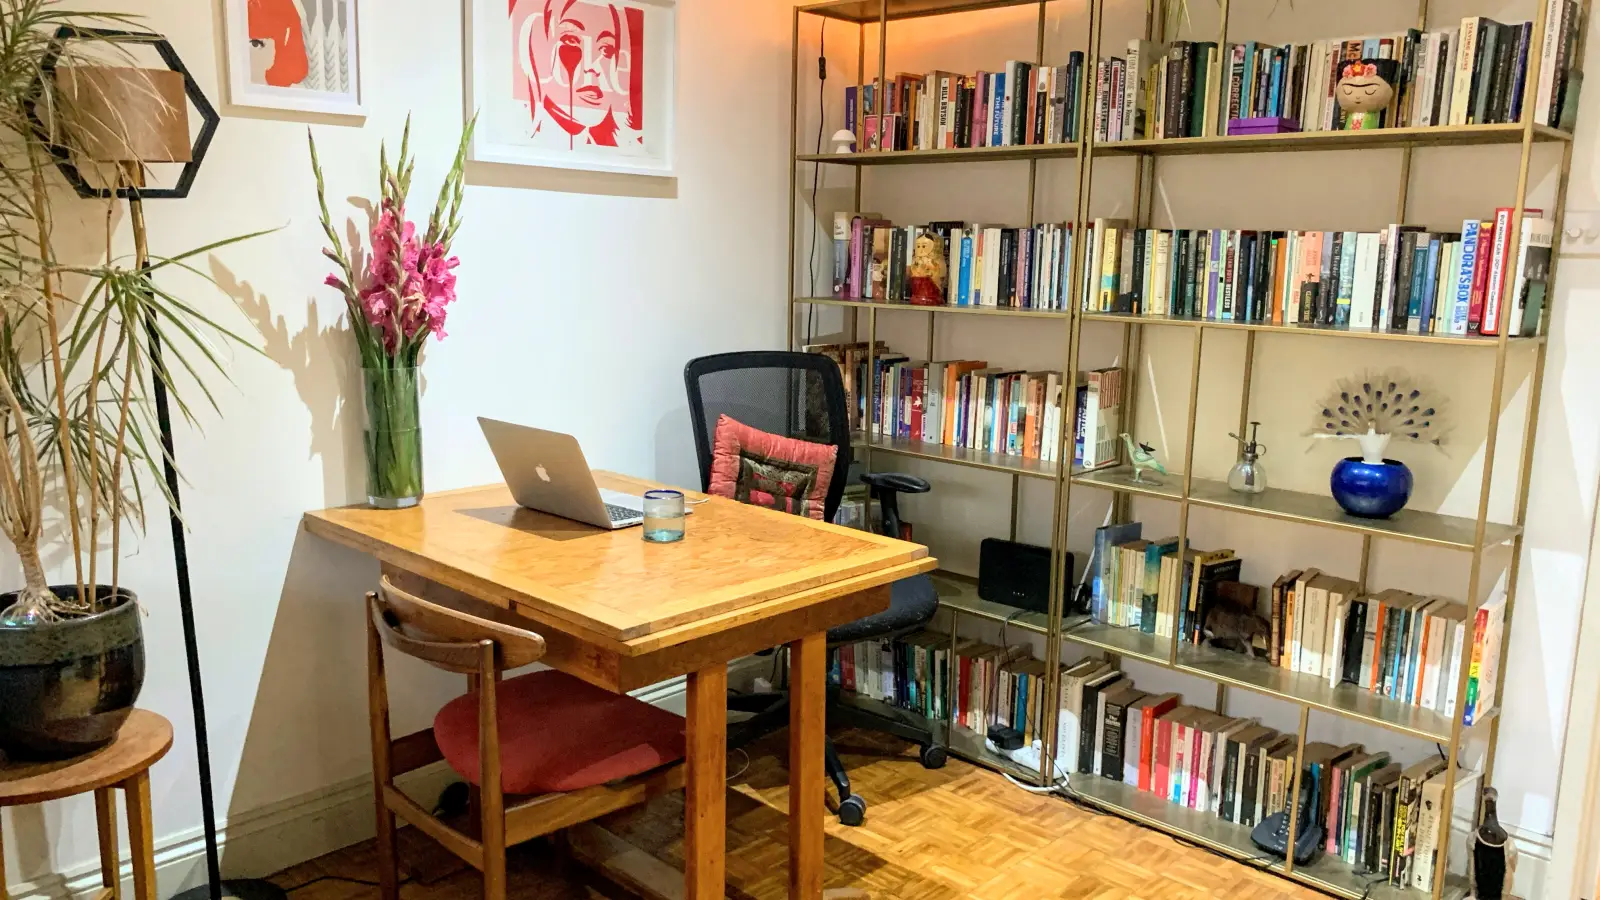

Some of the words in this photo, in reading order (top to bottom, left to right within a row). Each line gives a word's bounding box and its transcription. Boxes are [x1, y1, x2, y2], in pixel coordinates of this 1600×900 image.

[1465, 22, 1473, 50] STAYING
[1460, 222, 1478, 283] PANDORA'S
[1456, 284, 1469, 303] BOX
